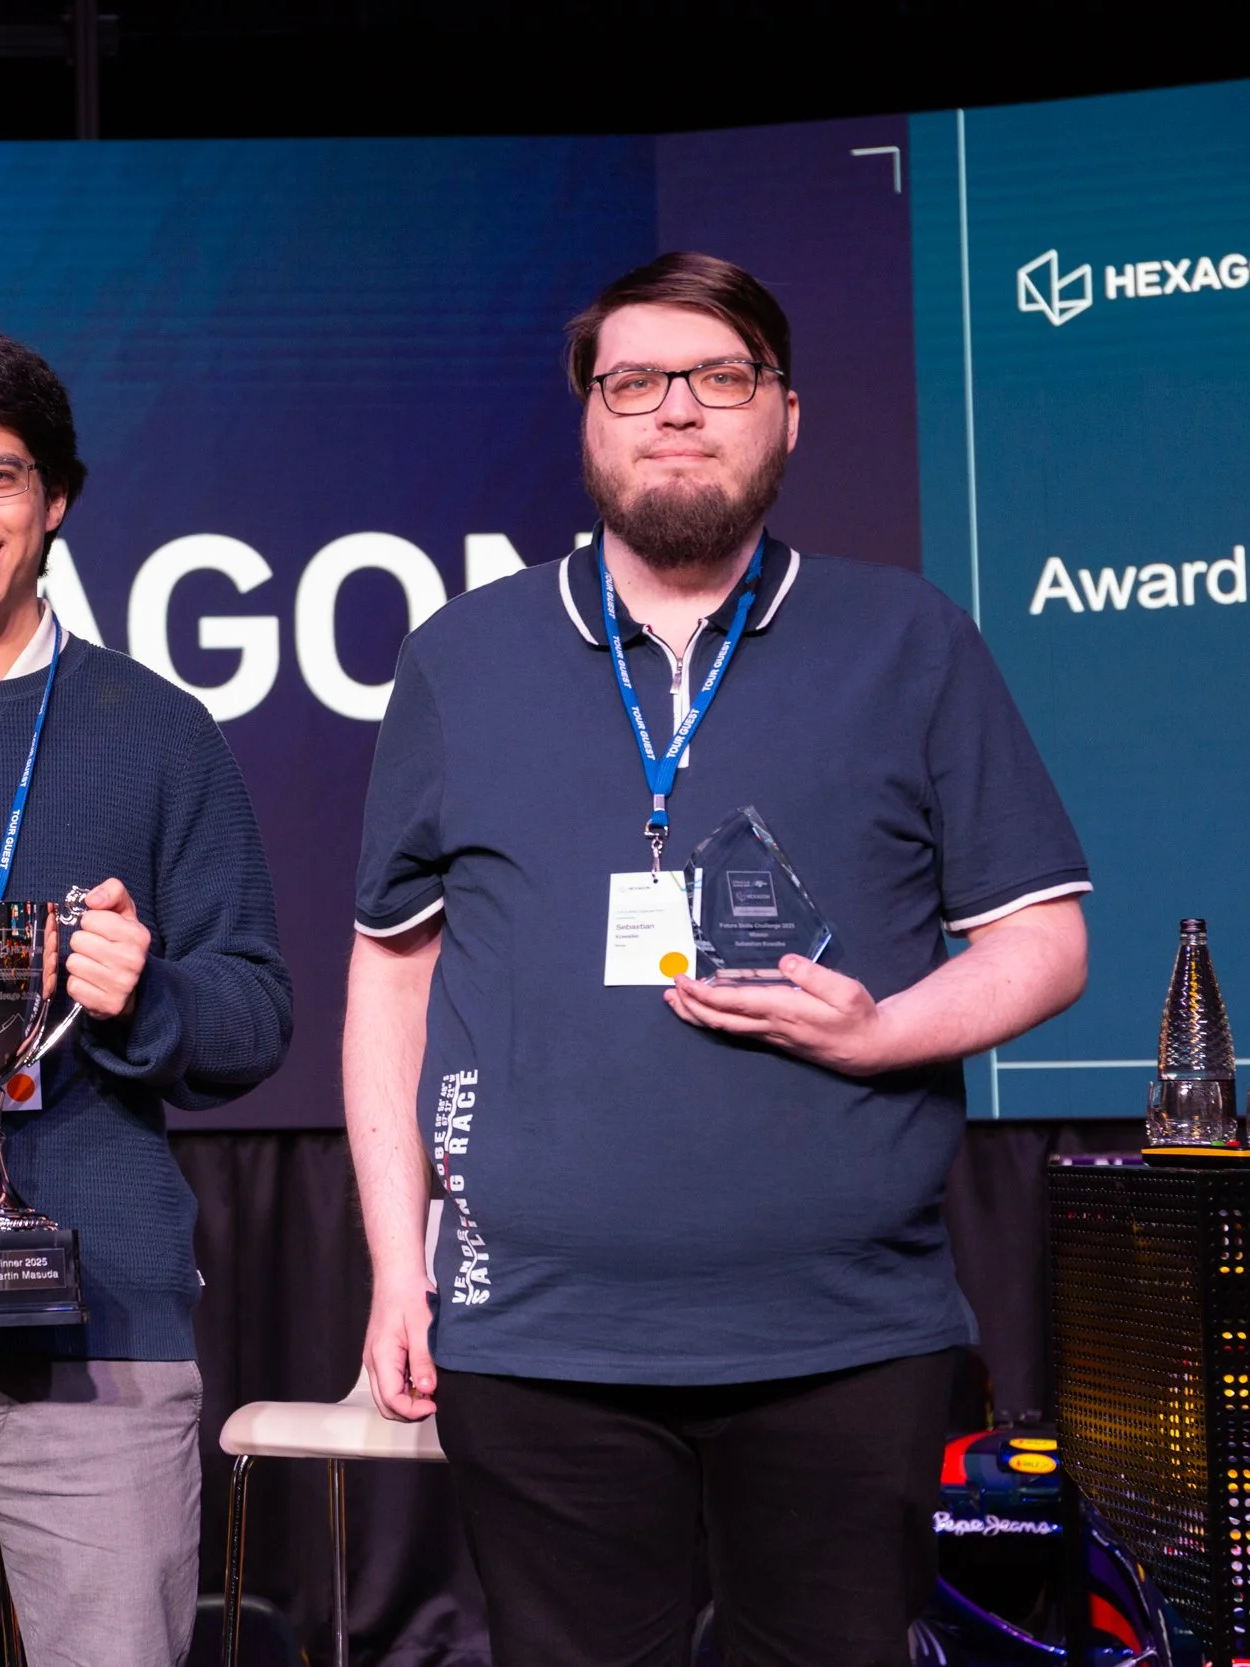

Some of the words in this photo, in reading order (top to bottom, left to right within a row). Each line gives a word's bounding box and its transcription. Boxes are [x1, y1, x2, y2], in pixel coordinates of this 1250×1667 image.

[1105, 253, 1250, 300] HEXAG
[1029, 544, 1248, 615] Award
[613, 635, 624, 660] TOUR
[618, 659, 632, 689] GUEST
[701, 669, 720, 692] TOUR
[713, 640, 731, 668] GUEST
[631, 706, 646, 730] TOUR
[640, 730, 656, 761] GUEST
[666, 735, 686, 759] TOUR
[679, 708, 700, 736] GUEST
[8, 809, 21, 836] TOUR
[0, 836, 14, 870] GUEST
[615, 923, 655, 931] Sebastian
[448, 1069, 479, 1155] RACE
[21, 1269, 59, 1280] Masuda
[24, 1257, 48, 1267] 2025
[932, 1511, 985, 1536] Pepe
[982, 1514, 1053, 1536] Jeans
